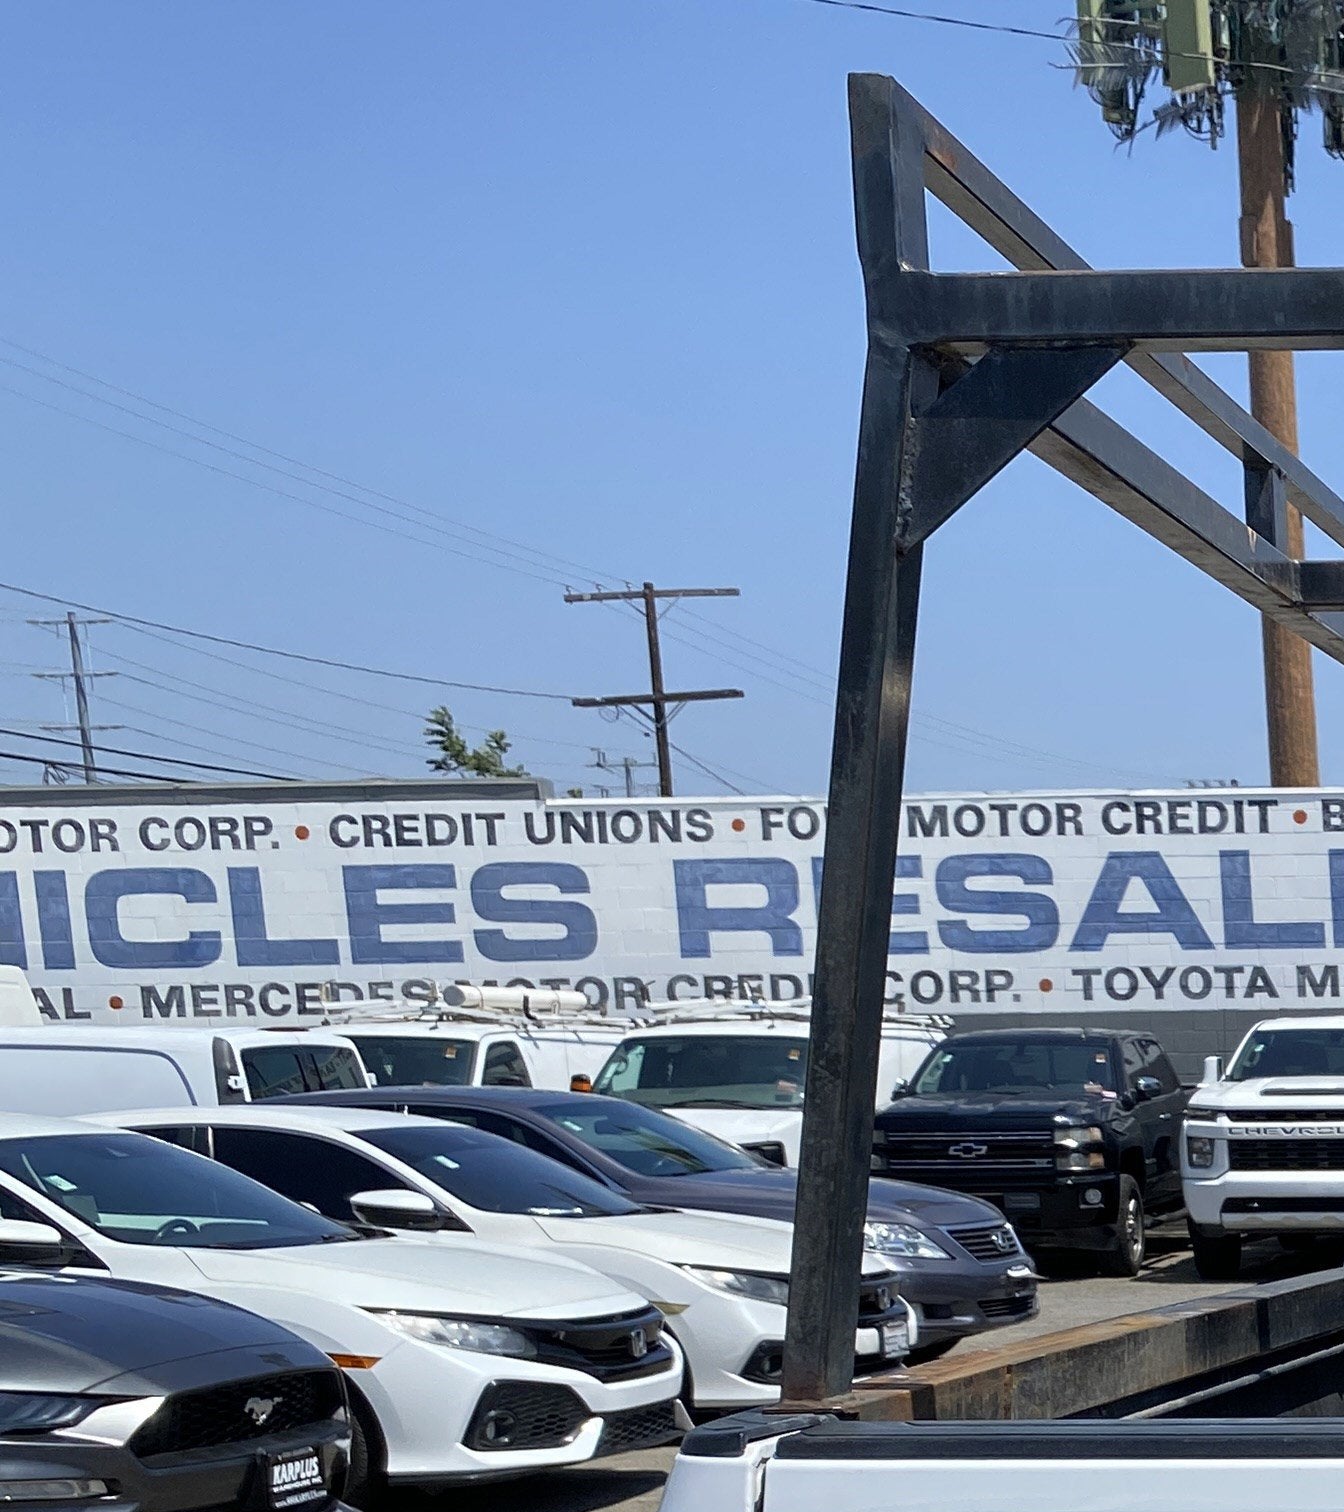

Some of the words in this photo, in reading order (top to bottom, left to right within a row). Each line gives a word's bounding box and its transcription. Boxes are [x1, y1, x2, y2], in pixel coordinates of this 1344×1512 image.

[139, 815, 280, 852] CORP.
[329, 812, 505, 848] CREDIT
[524, 808, 714, 845] UNIONS
[907, 803, 1084, 838] MOTOR
[1100, 799, 1278, 836] CREDIT
[0, 861, 599, 970] ICLES
[667, 973, 815, 1001] CRED
[883, 968, 1021, 1006] CORP.
[1072, 964, 1279, 1002] TOYOTA
[272, 1456, 320, 1486] KARPLUS
